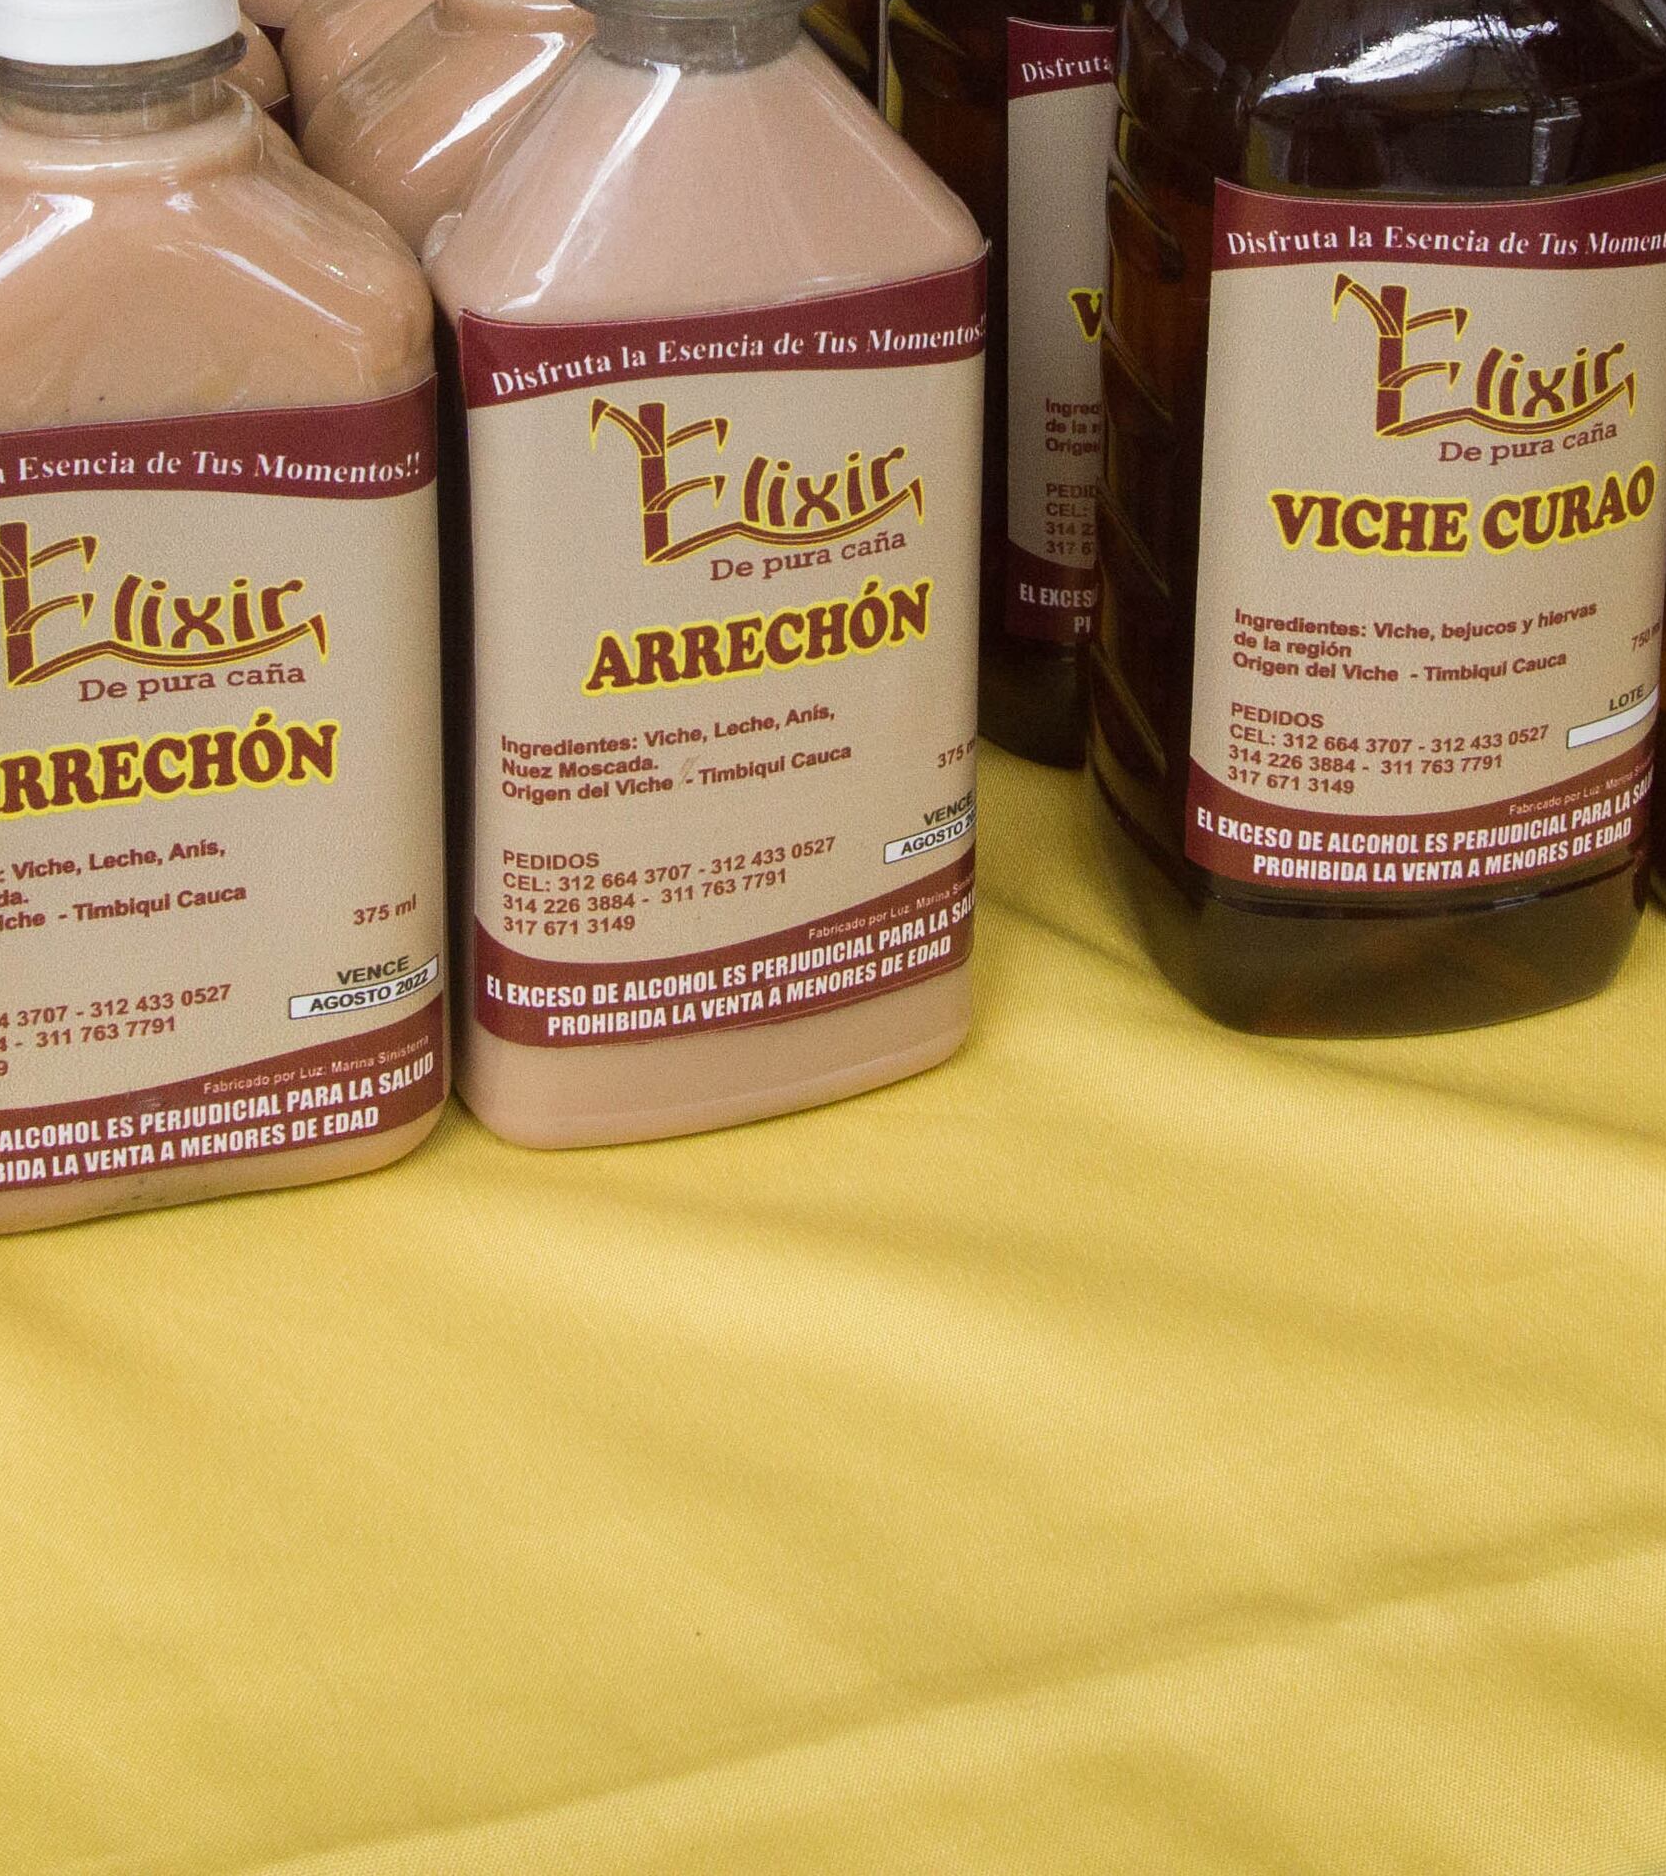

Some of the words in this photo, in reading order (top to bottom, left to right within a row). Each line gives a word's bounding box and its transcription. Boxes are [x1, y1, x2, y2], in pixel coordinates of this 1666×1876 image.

[1227, 228, 1338, 255] Disfruta
[1349, 226, 1373, 247] la
[1384, 226, 1488, 253] Esencia
[1499, 233, 1530, 254] de
[1538, 233, 1578, 256] Tus
[491, 353, 611, 397] Disfruta
[621, 346, 646, 370] la
[658, 334, 764, 365] Esencia
[773, 333, 805, 355] de
[813, 331, 858, 354] Tus
[1333, 272, 1635, 439] Elixir
[1439, 441, 1481, 462] De
[1490, 438, 1554, 465] pura
[1563, 422, 1618, 449] caña
[19, 452, 135, 480] Esencia
[147, 453, 181, 475] de
[193, 451, 243, 476] Tus
[255, 451, 420, 484] Momentos!!
[591, 398, 925, 565] Elixir
[1268, 489, 1469, 556] VICHE
[1480, 460, 1658, 556] CURAO
[709, 558, 754, 581] De
[763, 547, 831, 579] pura
[841, 530, 906, 561] caña
[582, 575, 933, 697] ARRECHÓN
[1234, 632, 1257, 648] de
[1264, 635, 1281, 652] la
[1287, 638, 1351, 659] región
[1235, 607, 1367, 638] Ingredientes:
[1373, 622, 1435, 642] Viche,
[1442, 619, 1516, 641] bejucos
[1521, 618, 1533, 636] y
[1537, 602, 1597, 627] hiervas
[79, 679, 128, 703] De
[137, 672, 215, 701] pura
[226, 662, 306, 687] caña
[1608, 684, 1644, 711] LOTE
[486, 975, 502, 999] EL
[507, 976, 586, 1009] EXCESO
[592, 981, 619, 1005] DE
[624, 971, 718, 1002] ALCOHOL
[722, 966, 745, 988] ES
[751, 939, 874, 982] PERJUDICIAL
[879, 925, 925, 951] PARA
[928, 916, 949, 937] LA
[548, 1007, 666, 1037] PROHIBIDA
[672, 1007, 695, 1026] LA
[701, 992, 764, 1020] VENTA
[769, 989, 781, 1008] A
[786, 963, 876, 1002] MENORES
[881, 954, 903, 978] DE
[907, 935, 952, 969] EDAD
[16, 1005, 68, 1027] 3707
[90, 997, 130, 1019] 312
[135, 992, 176, 1013] 433
[180, 983, 232, 1008] 0527
